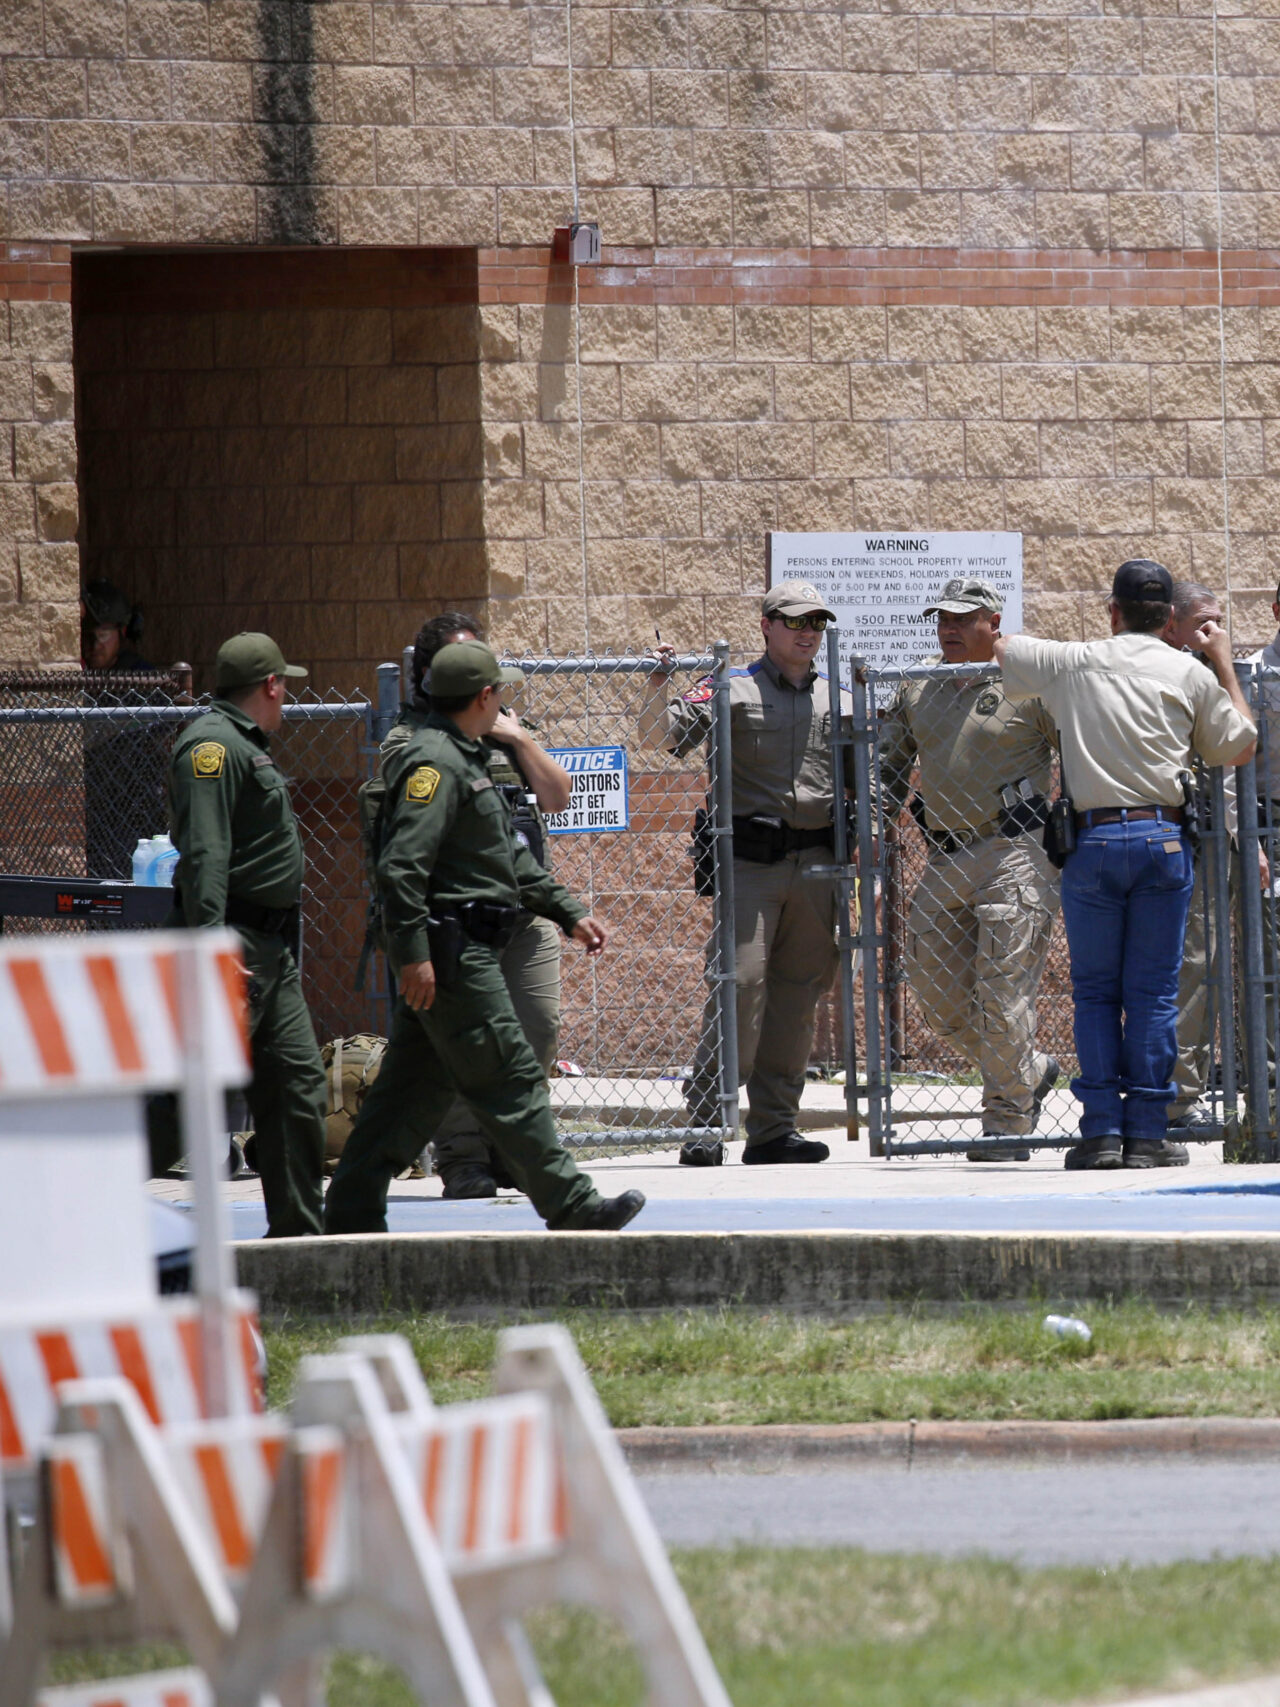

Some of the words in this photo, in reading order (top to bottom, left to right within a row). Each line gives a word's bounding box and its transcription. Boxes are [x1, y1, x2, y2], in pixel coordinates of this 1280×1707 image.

[865, 539, 929, 551] WARNING
[787, 557, 828, 566] PERSONS
[831, 557, 875, 566] ENTERING
[879, 557, 914, 566] SCHOOL
[917, 557, 963, 566] PROPERTY
[967, 557, 1007, 566] WITHOUT
[783, 570, 835, 579] PERMISSION
[838, 570, 851, 579] ON
[855, 570, 906, 580] WEEKENDS,
[909, 570, 949, 579] HOLIDAYS
[953, 570, 966, 578] OR
[969, 570, 1012, 579] BETWEEN
[831, 583, 843, 592] OF
[868, 583, 881, 592] PM
[884, 583, 901, 591] AND
[927, 583, 940, 591] AM
[996, 583, 1016, 591] DAYS
[828, 595, 866, 604] SUBJECT
[871, 595, 882, 604] TO
[886, 595, 920, 604] ARREST
[855, 614, 884, 625] $500
[890, 614, 939, 625] REWARD
[839, 629, 855, 638] FOR
[858, 628, 916, 637] INFORMATION
[852, 641, 885, 650] ARREST
[890, 641, 908, 650] AND
[865, 654, 877, 663] OR
[880, 654, 899, 662] ANY
[549, 751, 616, 771] NOTICE
[588, 794, 606, 809] GET
[543, 812, 569, 828] PASS
[573, 813, 585, 826] AT
[588, 811, 619, 825] OFFICE
